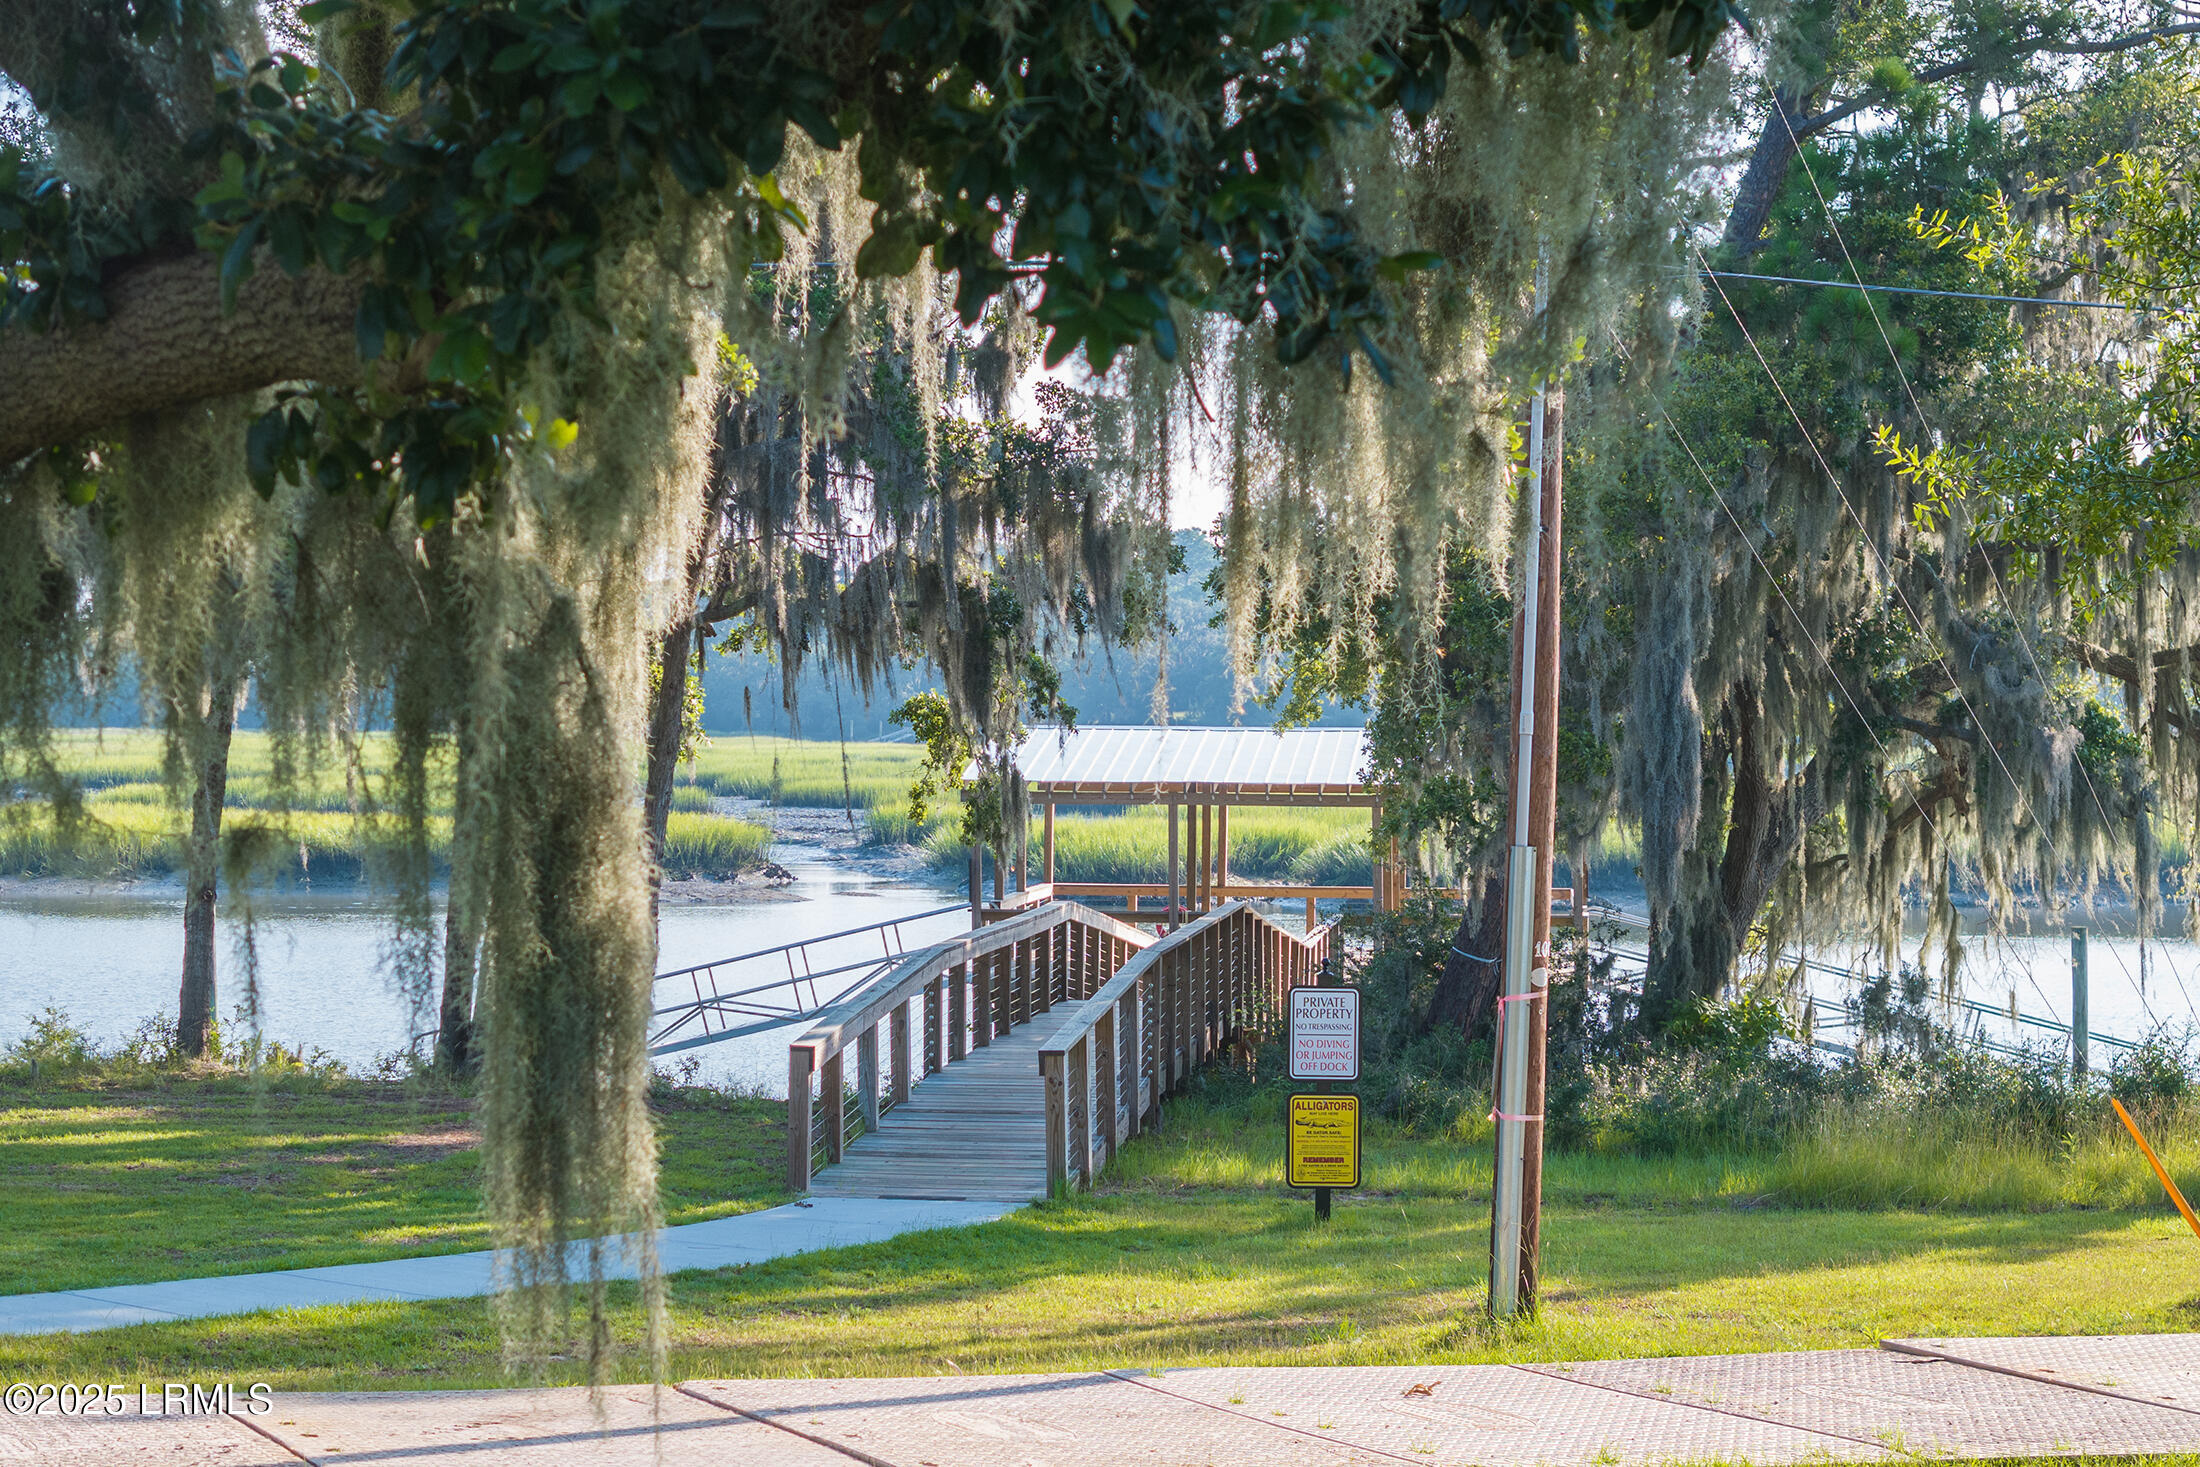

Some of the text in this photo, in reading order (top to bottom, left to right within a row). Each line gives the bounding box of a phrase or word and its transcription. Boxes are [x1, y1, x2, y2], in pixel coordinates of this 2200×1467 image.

[1303, 997, 1346, 1007] PRIVATE
[1295, 1008, 1353, 1019] PROPERTY
[1309, 1023, 1352, 1031] TRESPASSING
[1298, 1040, 1350, 1049] NO DIVING
[1295, 1051, 1353, 1061] OR JUMPING
[1300, 1062, 1349, 1072] OFF DOCK
[1295, 1101, 1354, 1111] ALLIGATORS
